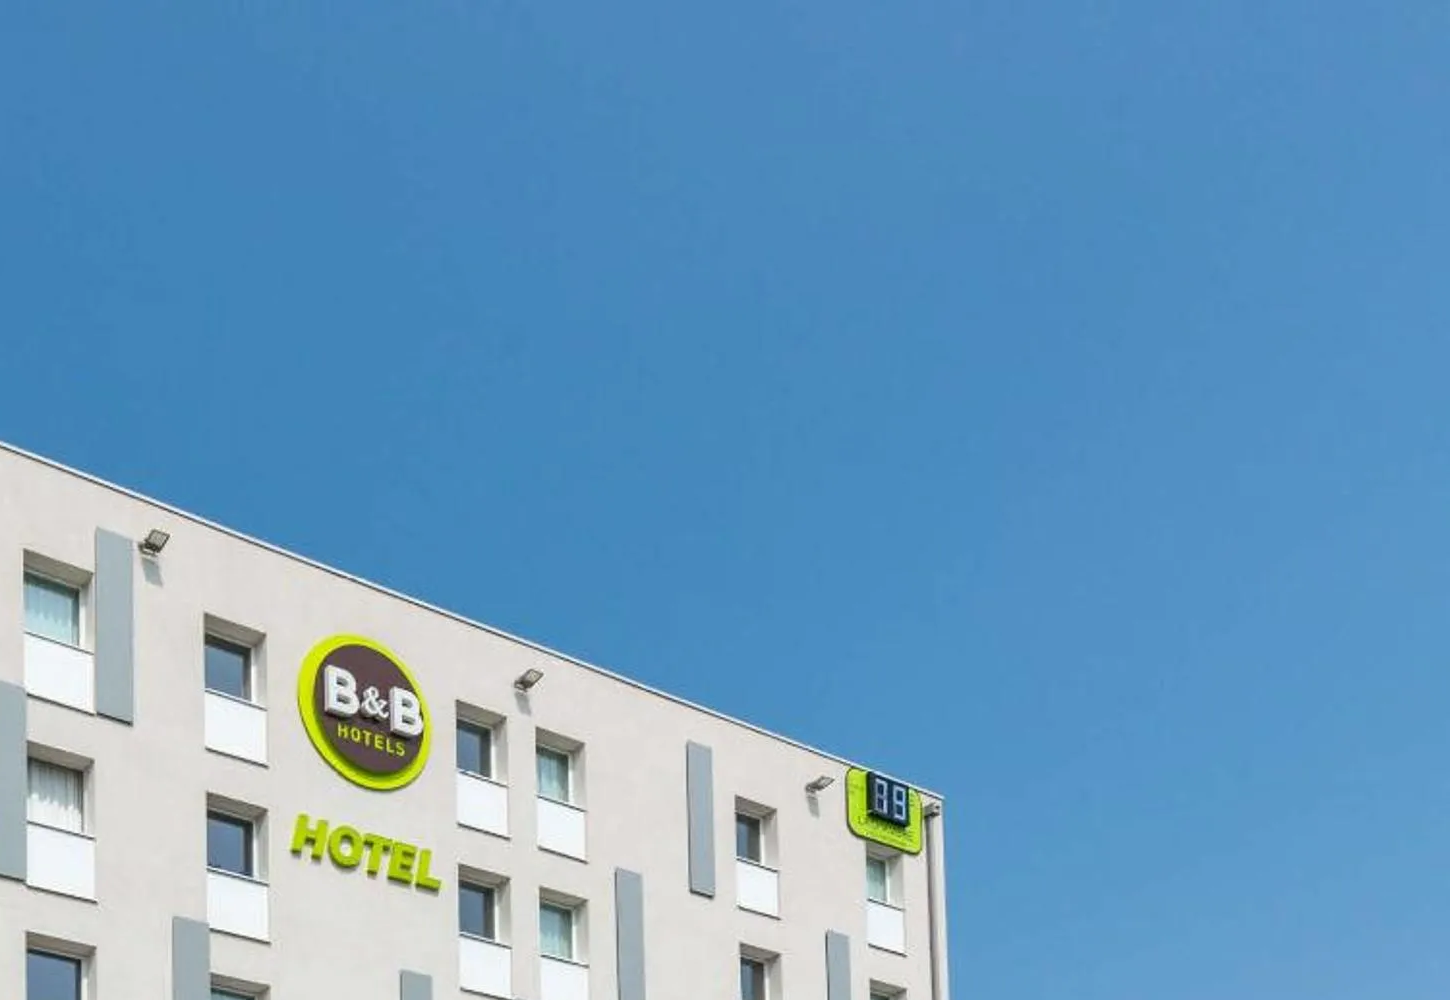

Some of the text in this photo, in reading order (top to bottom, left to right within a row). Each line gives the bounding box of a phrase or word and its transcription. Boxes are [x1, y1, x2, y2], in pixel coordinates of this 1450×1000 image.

[324, 664, 424, 737] B&B
[337, 722, 406, 757] HOTELS
[290, 813, 442, 892] HOTEL
